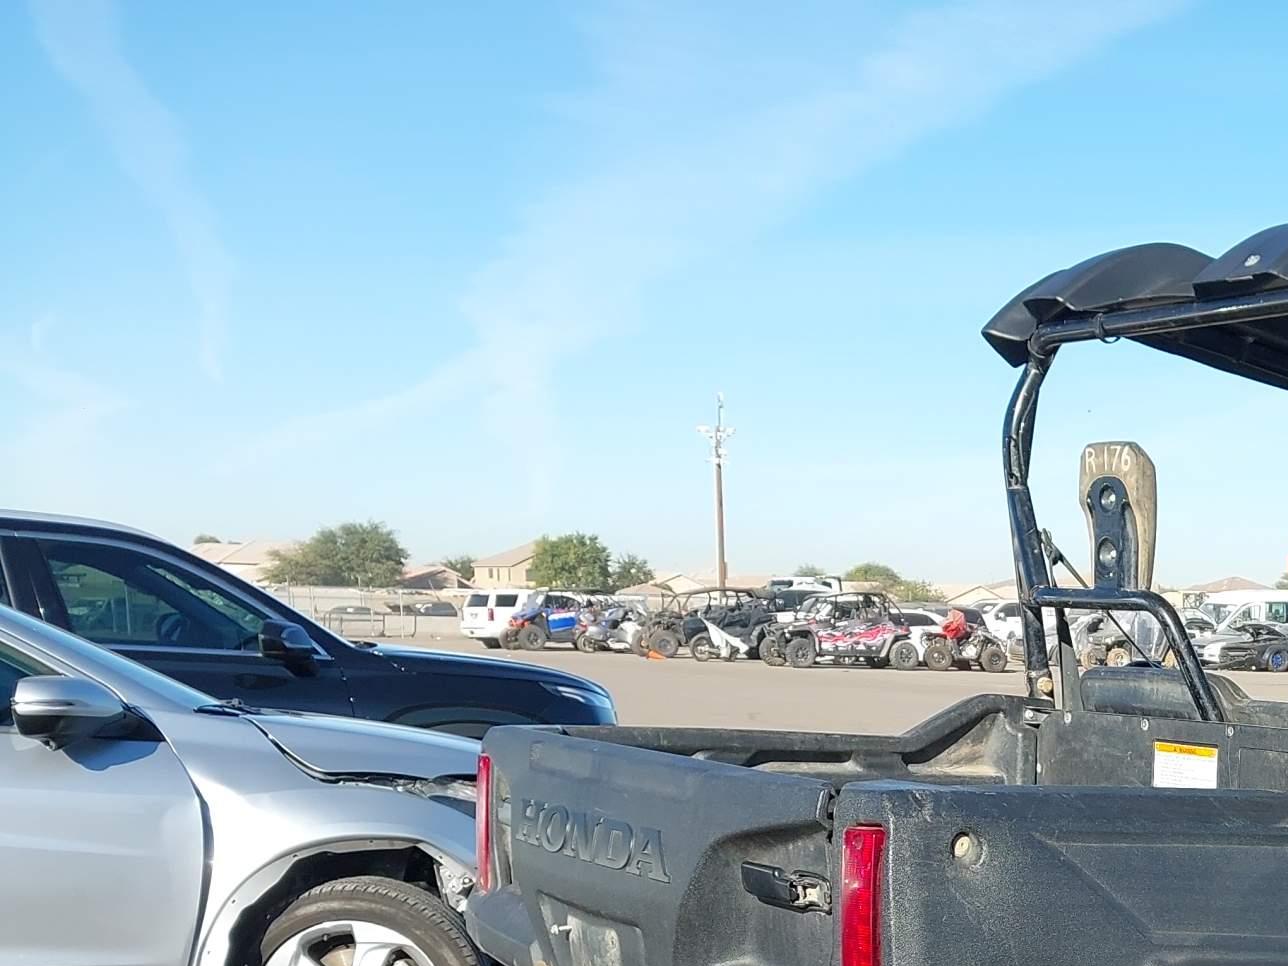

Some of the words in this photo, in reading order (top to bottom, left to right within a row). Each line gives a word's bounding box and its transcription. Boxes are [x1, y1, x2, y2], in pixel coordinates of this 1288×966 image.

[1085, 447, 1096, 473] R
[1103, 444, 1131, 472] 176
[515, 798, 672, 884] HONDA
